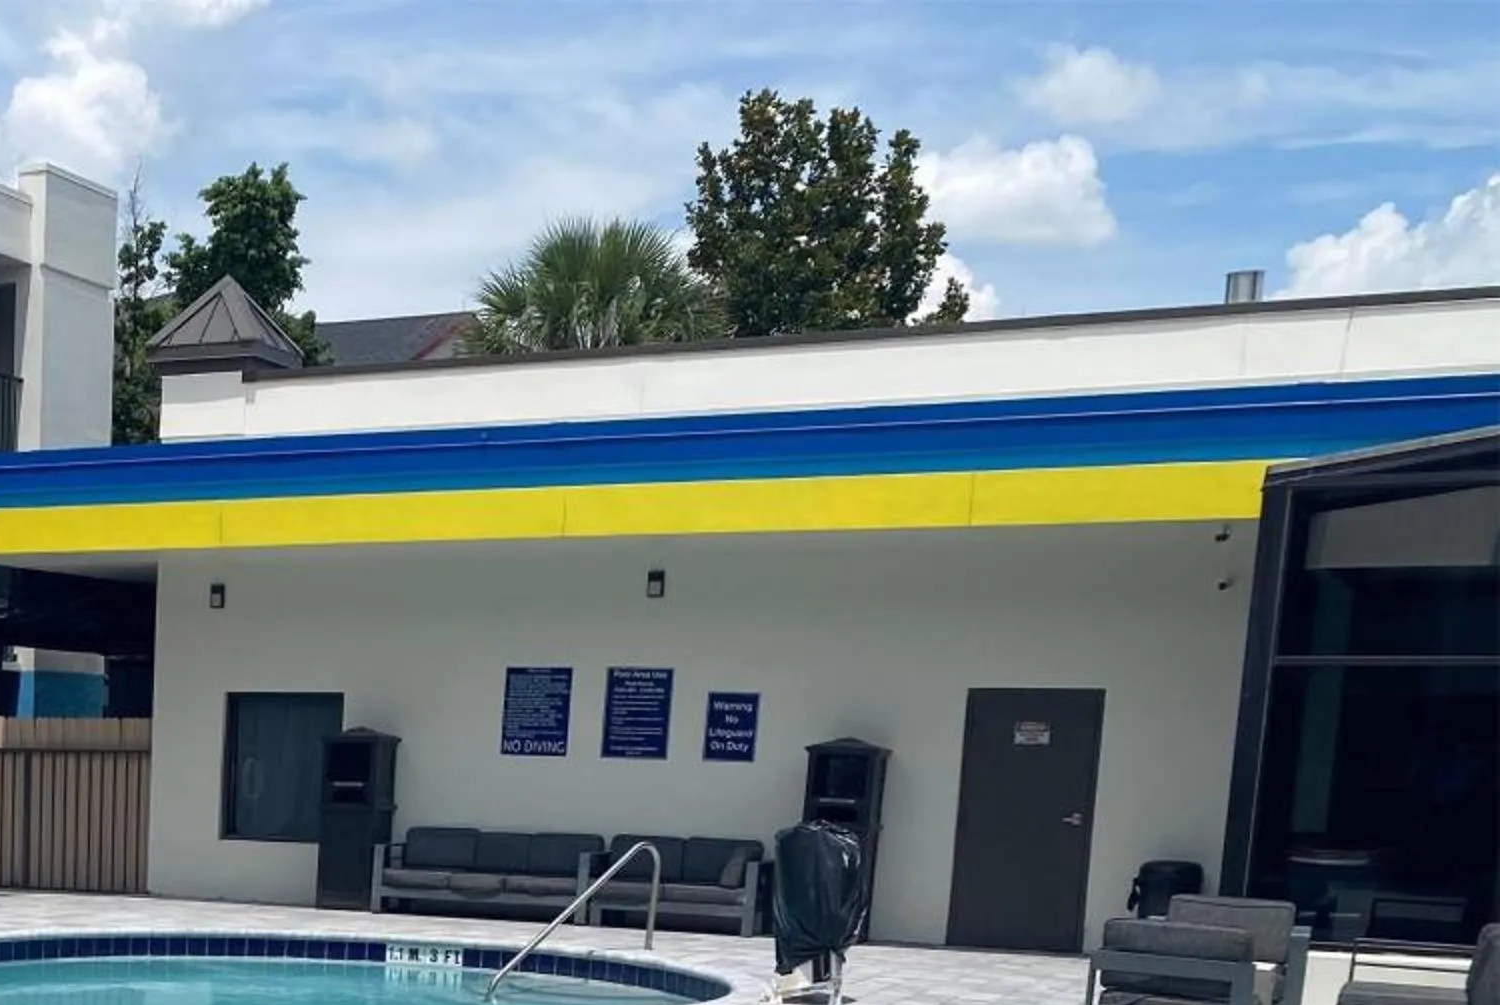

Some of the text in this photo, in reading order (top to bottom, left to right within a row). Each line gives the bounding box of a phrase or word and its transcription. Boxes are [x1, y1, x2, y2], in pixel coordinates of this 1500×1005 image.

[713, 700, 753, 713] Warning
[725, 714, 740, 724] No
[708, 727, 754, 739] Lifeguard
[503, 739, 565, 753] NO DIVING
[710, 740, 749, 753] On Duty
[429, 947, 439, 963] 3
[445, 949, 460, 964] FT
